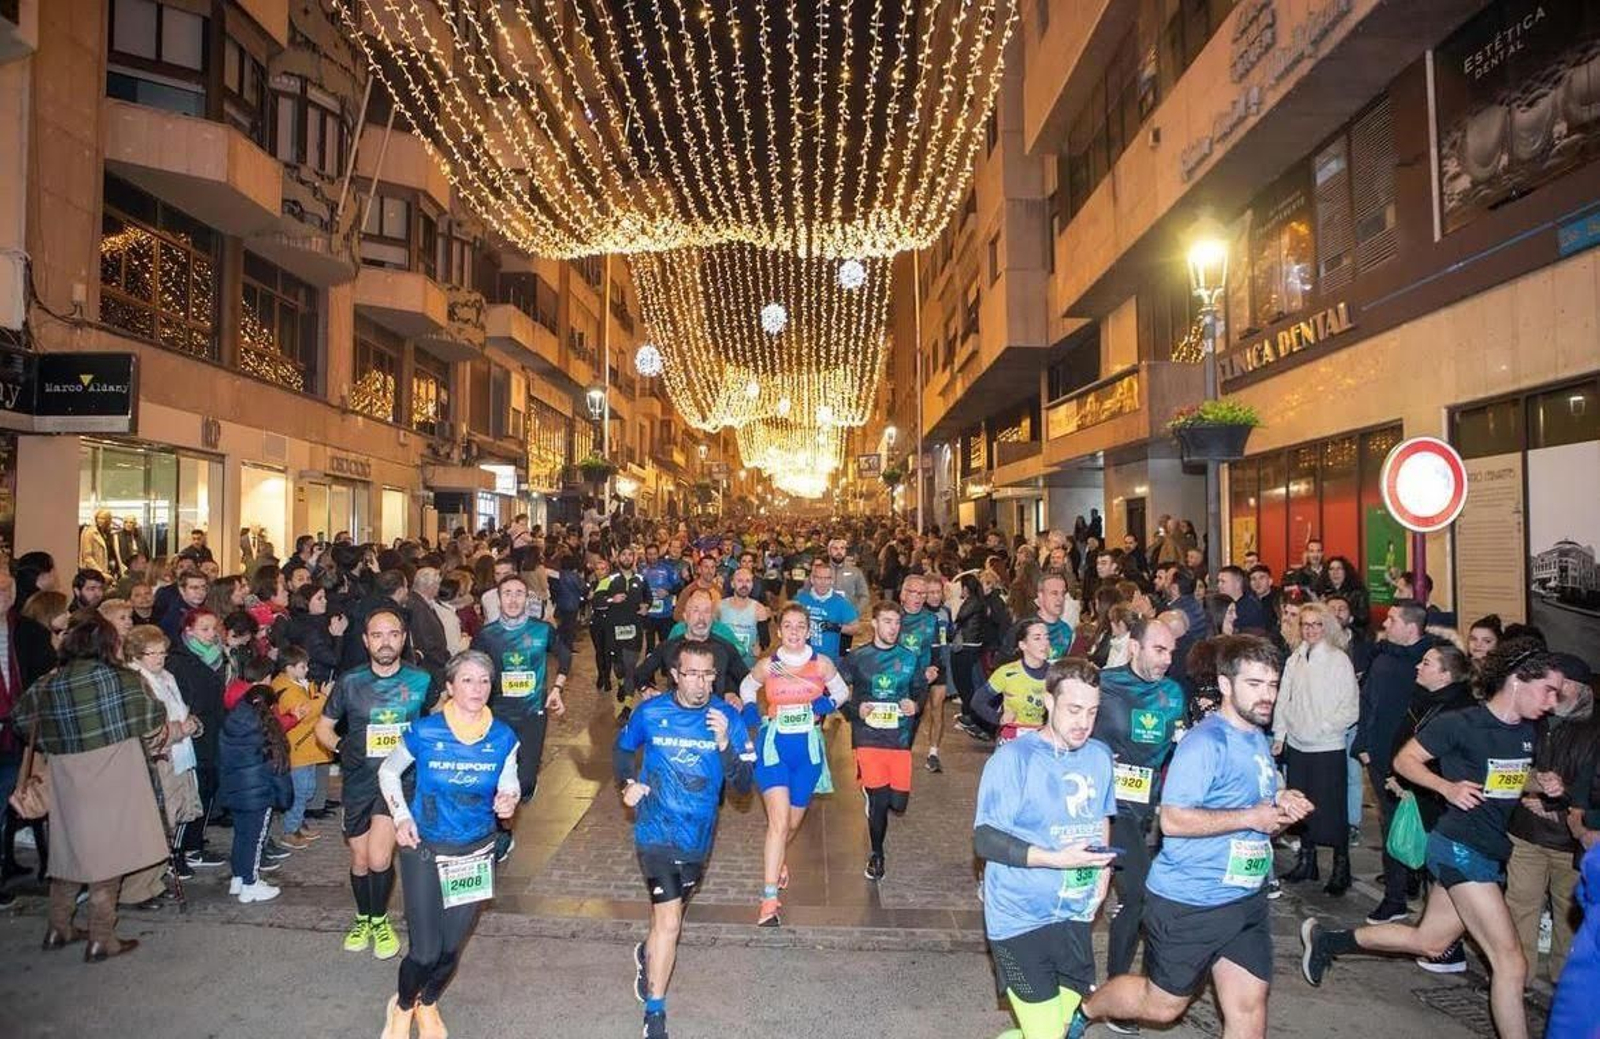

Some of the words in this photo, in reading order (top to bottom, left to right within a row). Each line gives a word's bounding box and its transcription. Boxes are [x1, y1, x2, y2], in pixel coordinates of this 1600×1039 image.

[1464, 6, 1546, 74] ESTÉTICA
[1475, 40, 1524, 79] DENTAL
[1277, 302, 1356, 358] DENTAL
[44, 382, 83, 393] Marco
[88, 382, 129, 395] Aldany
[651, 736, 679, 747] RUN
[679, 738, 718, 751] SPOR
[428, 761, 456, 771] RUN
[456, 762, 498, 773] SPORT
[1498, 773, 1524, 785] 7892
[1244, 857, 1266, 871] 347
[450, 875, 482, 891] 2408
